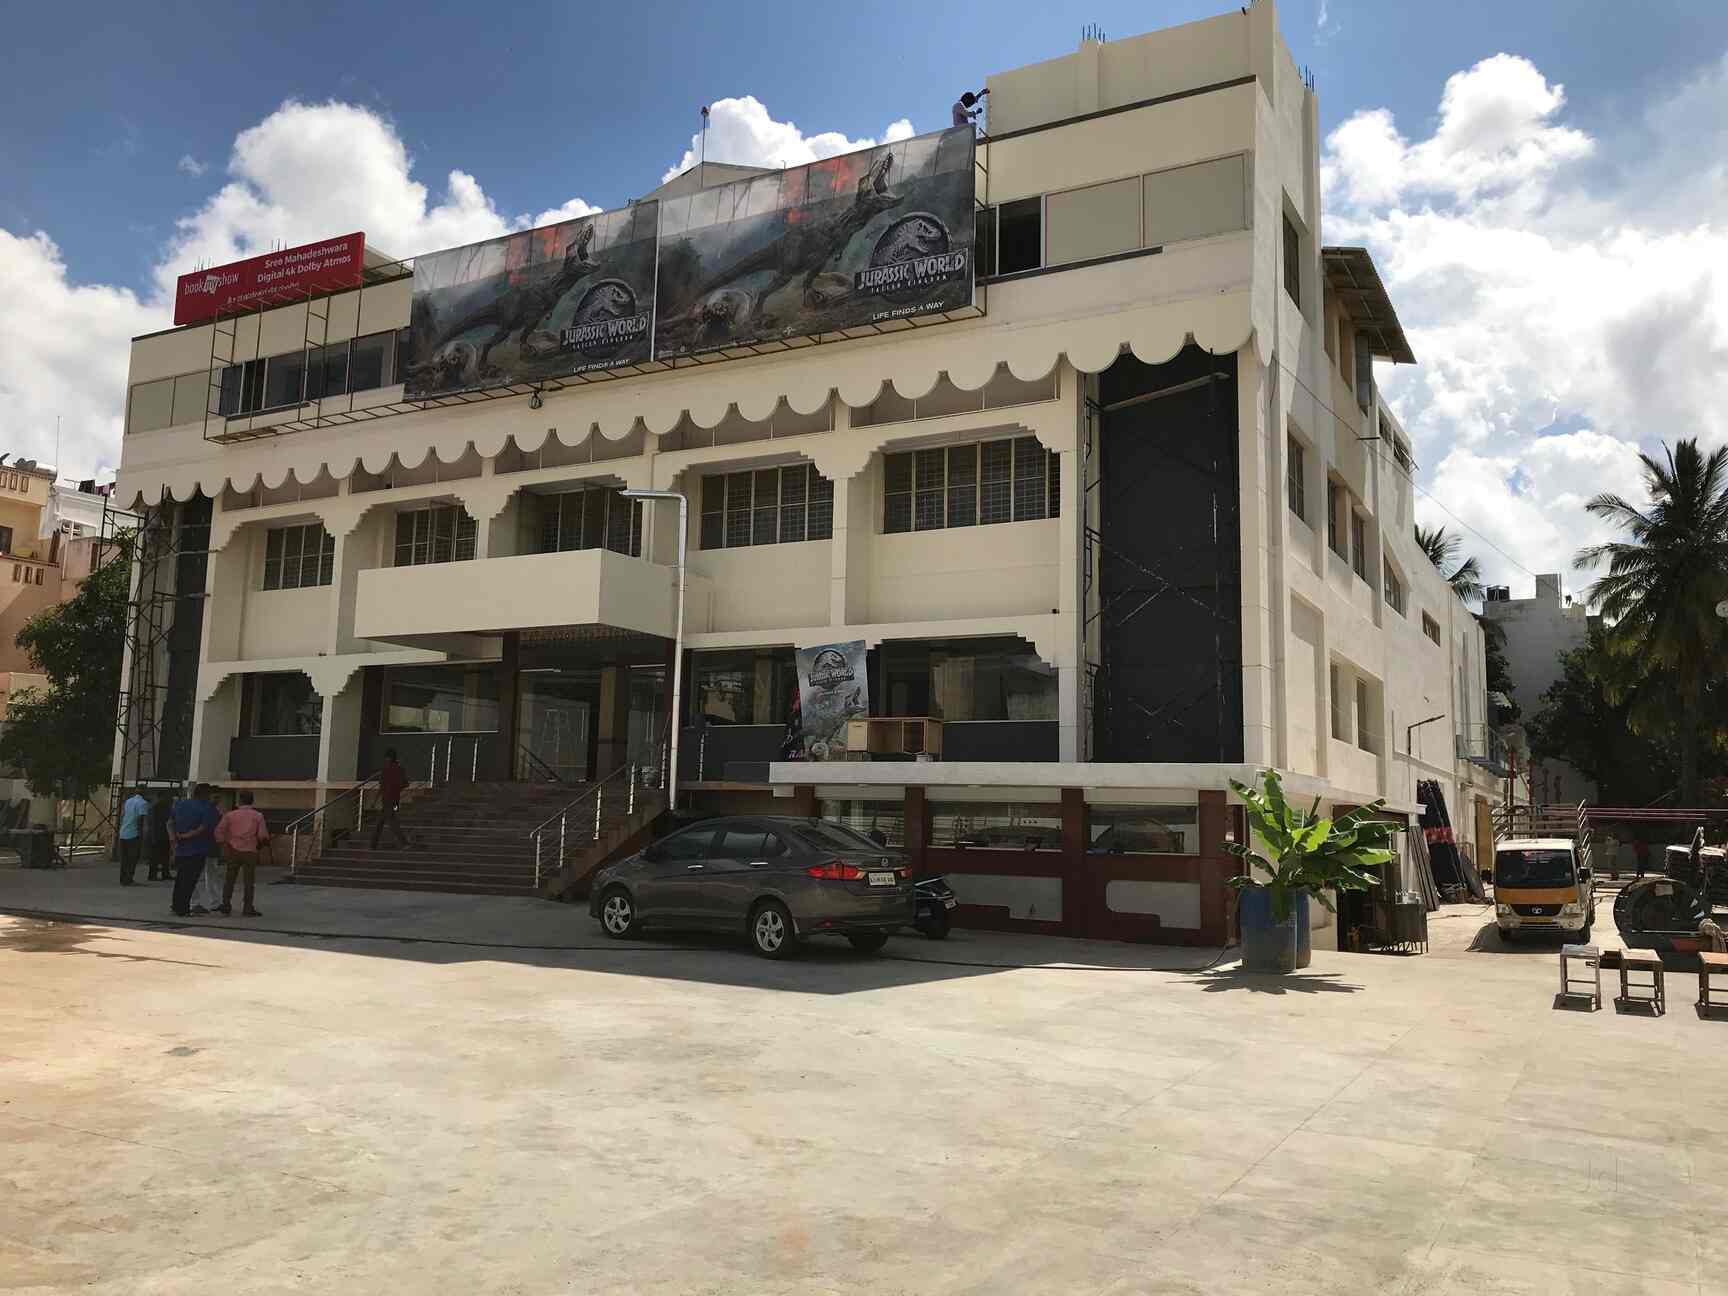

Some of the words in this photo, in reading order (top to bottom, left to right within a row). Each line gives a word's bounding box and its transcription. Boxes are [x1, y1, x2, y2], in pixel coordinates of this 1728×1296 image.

[257, 269, 285, 284] Digital
[297, 259, 322, 274] Dolby
[323, 254, 352, 269] Atmos
[264, 257, 284, 270] Sree
[284, 242, 348, 265] Mahadeshwara
[858, 263, 910, 290] JURASSIC
[914, 253, 965, 279] WORLD
[872, 311, 889, 320] LIFE
[891, 306, 917, 317] FINDS
[925, 301, 945, 310] WAY
[561, 325, 605, 346] JURASSIC
[607, 316, 647, 337] WORLD
